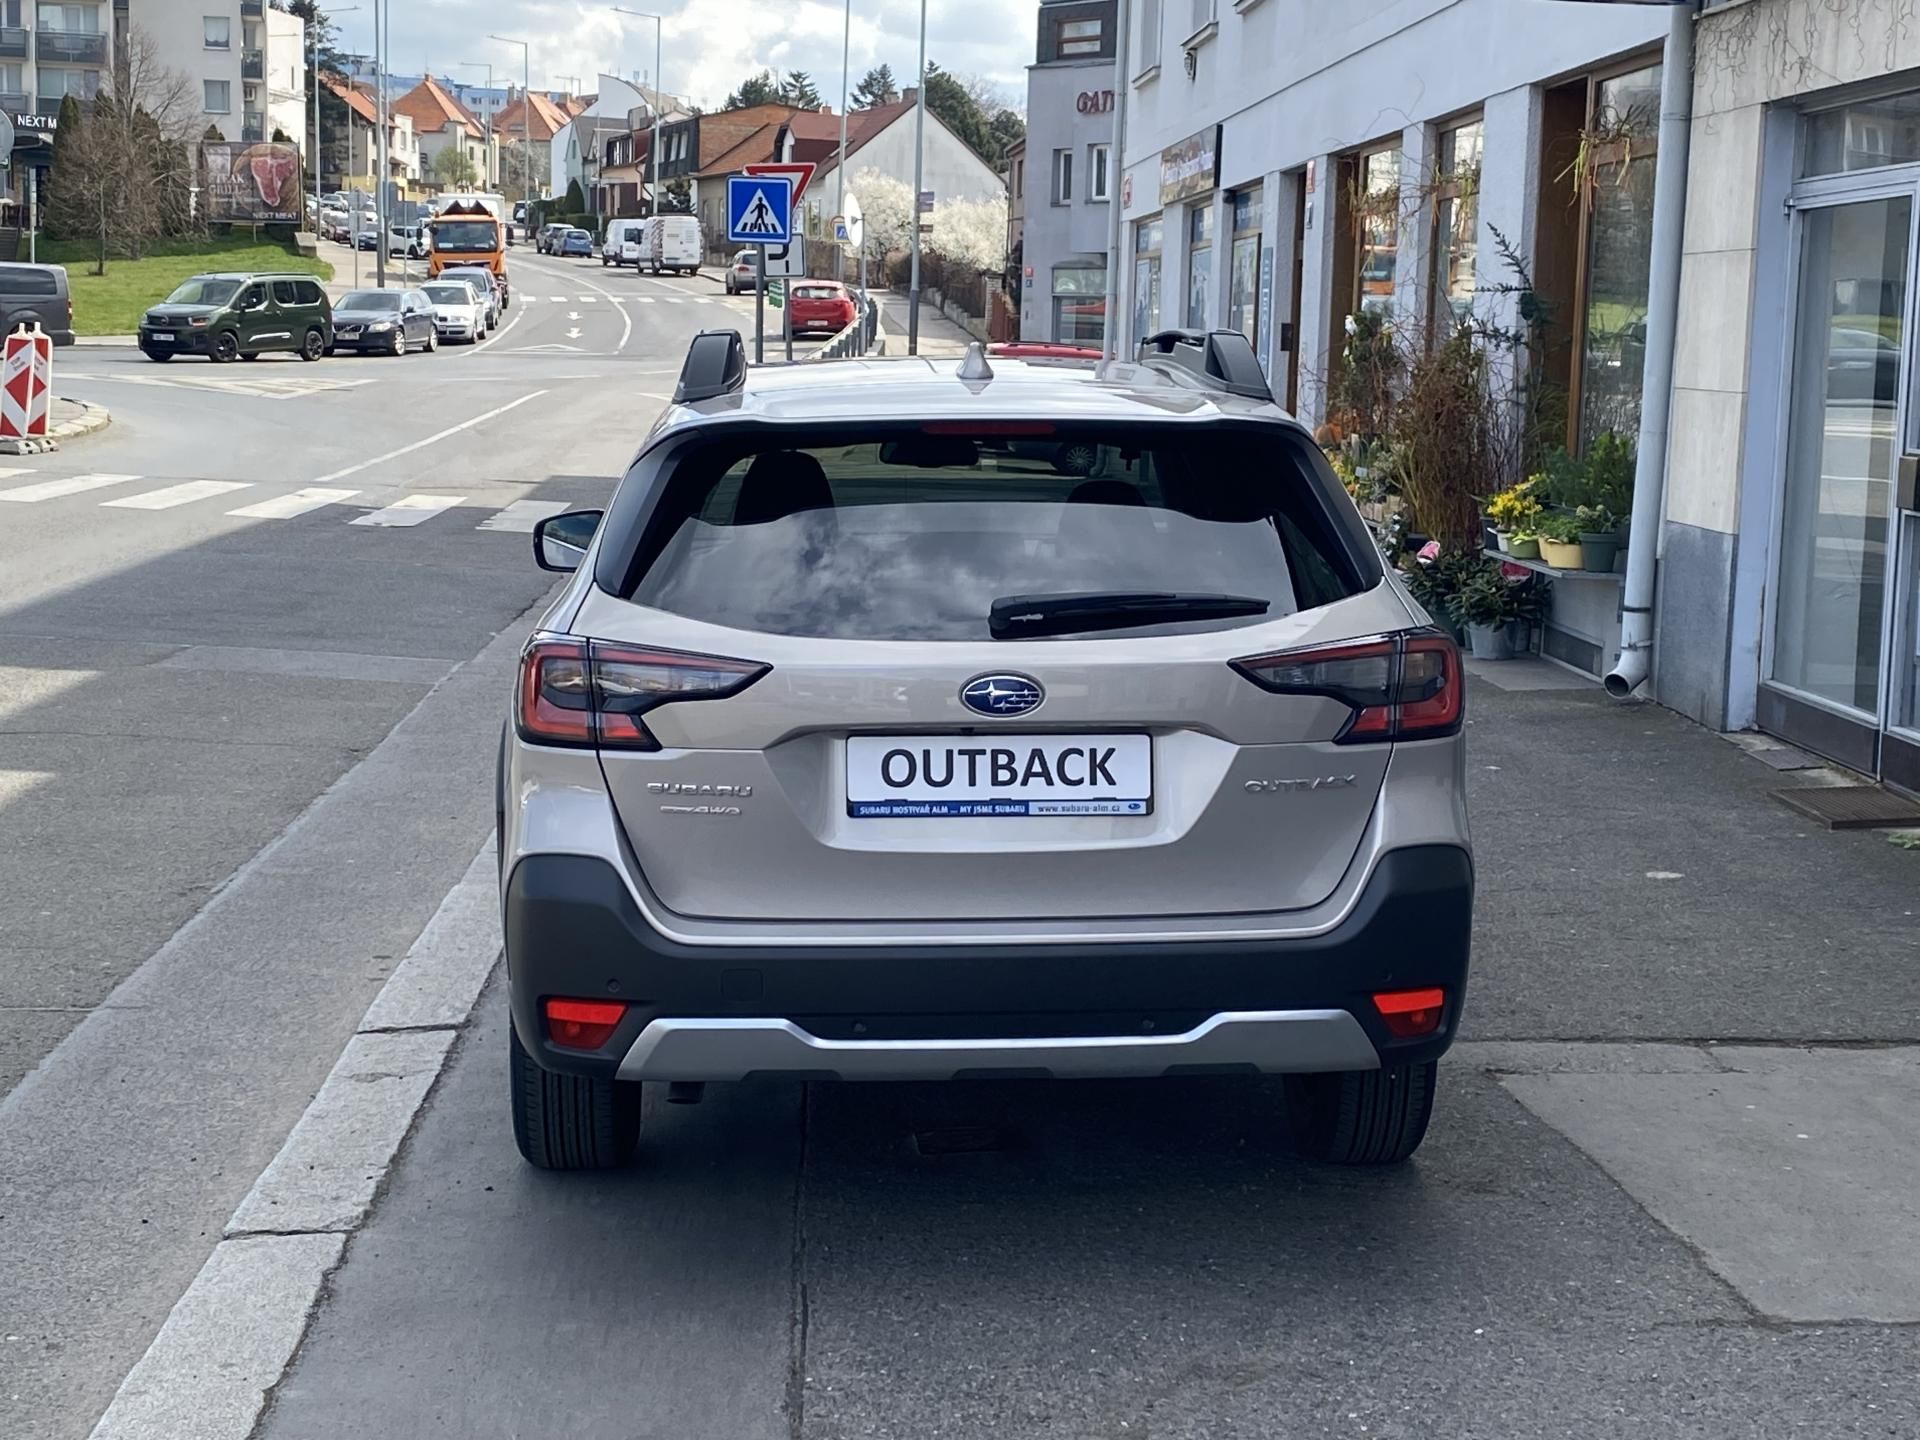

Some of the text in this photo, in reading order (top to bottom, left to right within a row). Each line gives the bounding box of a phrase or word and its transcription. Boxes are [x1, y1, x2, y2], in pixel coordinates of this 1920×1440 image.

[17, 114, 46, 128] NEXT
[252, 211, 297, 219] NEXT MEAT
[881, 747, 1117, 788] OUTBACK
[646, 782, 753, 797] SUBARU
[859, 805, 891, 815] SUBARU
[931, 804, 949, 815] ALM
[959, 804, 972, 814] MY
[973, 804, 992, 815] JSME
[994, 804, 1026, 814] SUBARU
